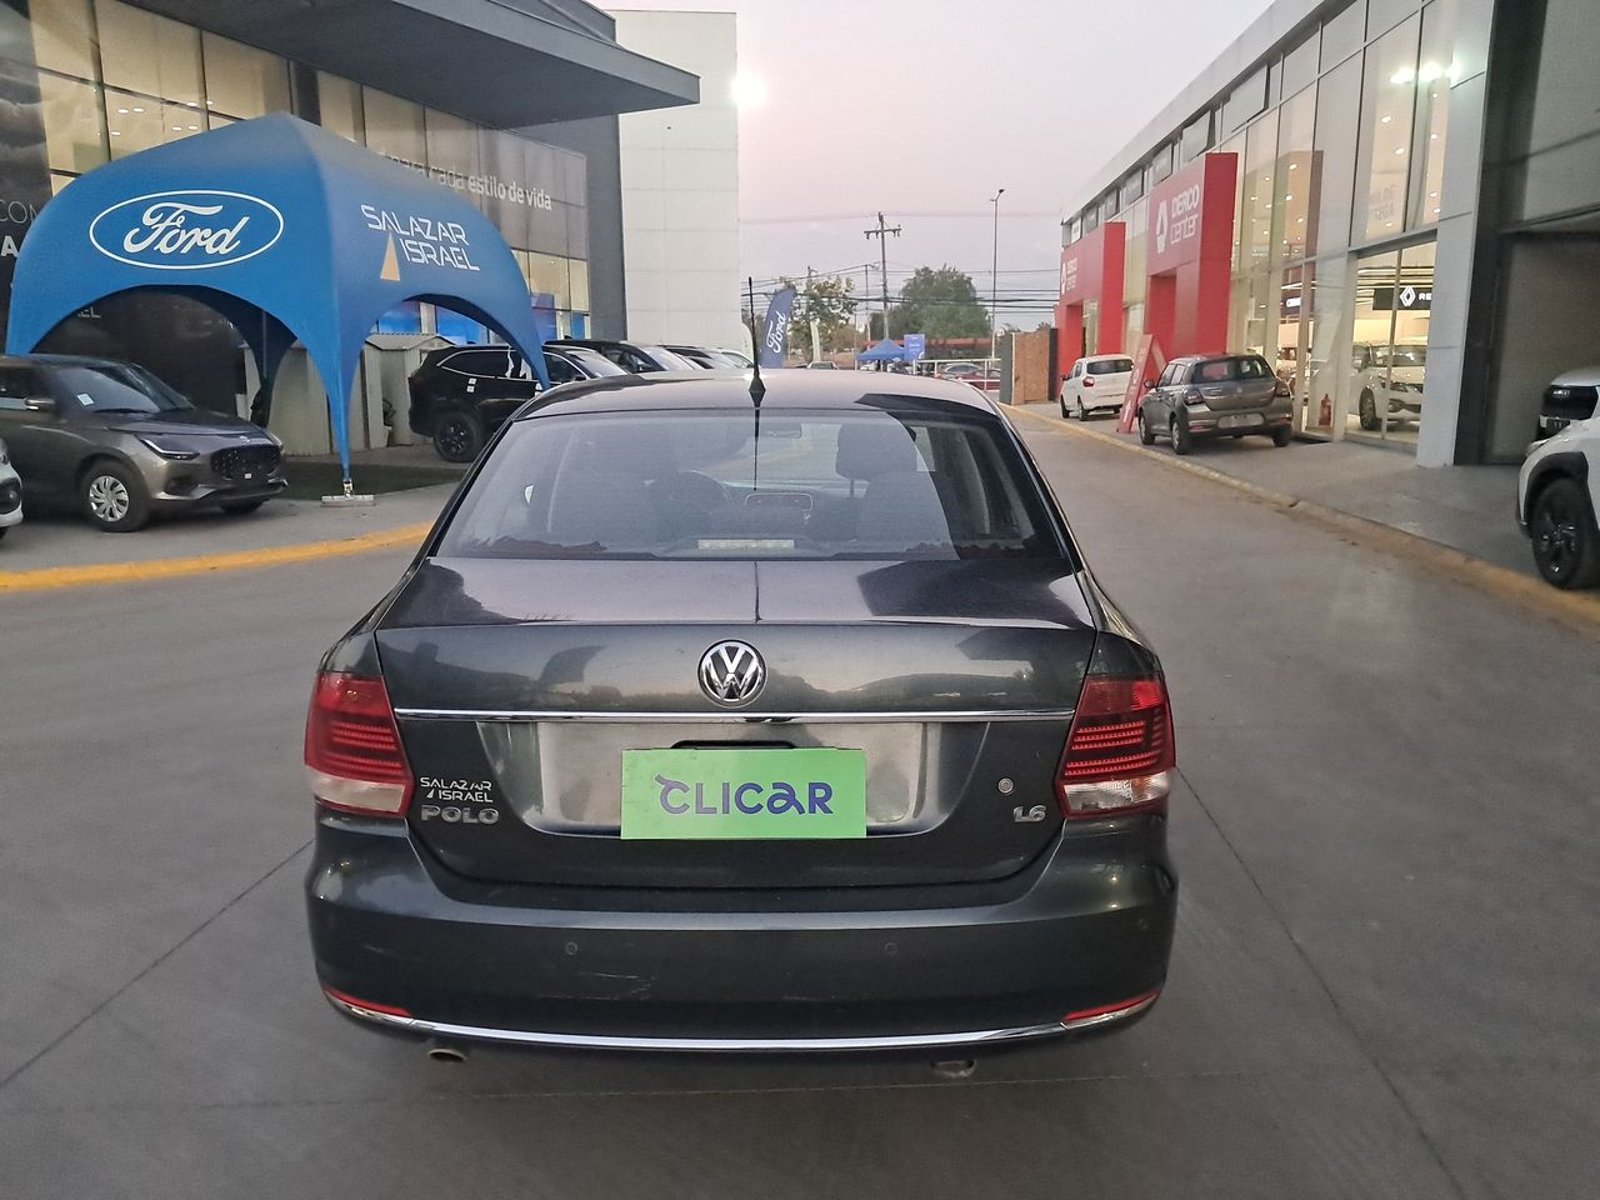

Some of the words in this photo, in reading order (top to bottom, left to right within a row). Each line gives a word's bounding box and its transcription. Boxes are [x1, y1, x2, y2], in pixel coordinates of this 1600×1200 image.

[468, 175, 506, 200] estilo
[508, 182, 525, 204] de
[525, 187, 552, 210] vida
[123, 202, 250, 255] Ford
[360, 204, 470, 246] SALAZAR
[400, 238, 480, 271] ISRAEL
[766, 310, 786, 353] Ford
[420, 776, 492, 791] SALAZAR
[438, 789, 494, 803] ISRAEL
[420, 804, 499, 825] POLO
